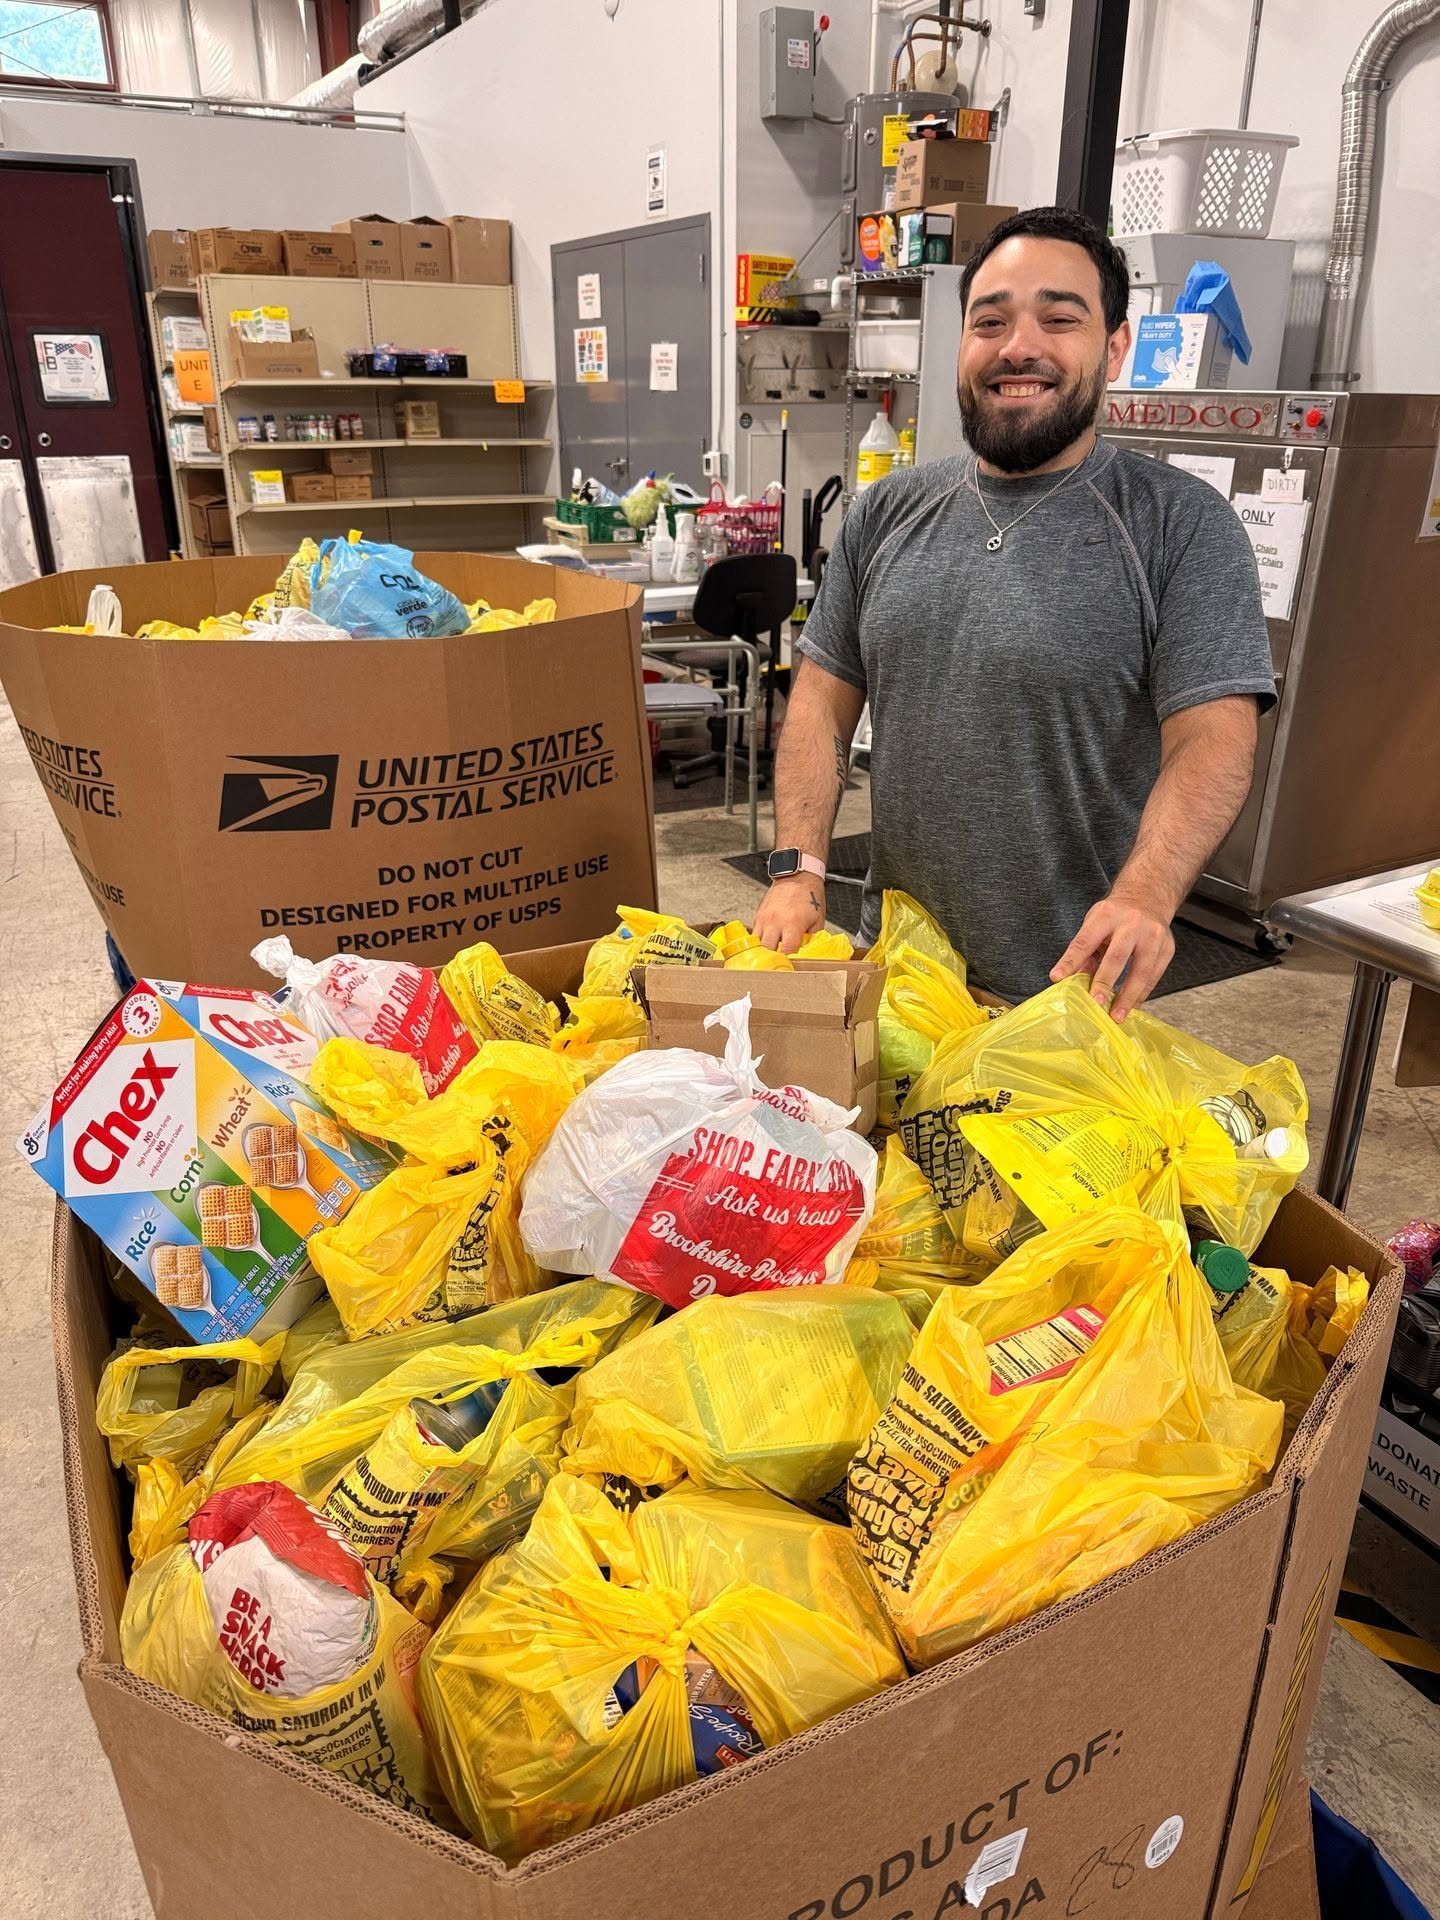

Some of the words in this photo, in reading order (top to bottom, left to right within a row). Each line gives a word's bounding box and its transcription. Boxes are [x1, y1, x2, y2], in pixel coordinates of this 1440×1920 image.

[179, 359, 209, 372] UNIT
[194, 379, 203, 391] E
[1106, 402, 1262, 429] MEDCO
[1267, 478, 1299, 492] DIRTY
[1241, 508, 1276, 524] ONLY
[1255, 543, 1278, 555] Chairs
[1261, 556, 1284, 568] Chairs
[395, 600, 428, 616] verde
[41, 735, 103, 778] STATES
[358, 746, 502, 789] UNITED
[508, 722, 605, 773] STATES
[351, 785, 494, 829] POSTAL
[500, 755, 615, 811] SERVICE
[377, 863, 416, 887] DO
[423, 856, 475, 882] NOT
[480, 846, 524, 873] CUT
[103, 883, 126, 907] USE
[260, 899, 400, 929] DESIGNED
[408, 890, 455, 915] FOR
[463, 868, 569, 906] MULTIPLE
[574, 854, 610, 880] USE
[336, 919, 467, 955] PROPERTY
[473, 911, 503, 932] OF
[509, 897, 562, 925] USPS
[694, 946, 712, 960] MAY
[124, 995, 148, 1024] INCLUDES
[132, 1006, 150, 1026] 3
[144, 1016, 160, 1035] BAGS
[208, 1013, 305, 1049] Chex
[54, 1079, 76, 1105] Perfect
[69, 1070, 83, 1085] for
[76, 1049, 99, 1076] Making
[92, 1034, 111, 1055] Party
[103, 1021, 120, 1039] Mix!
[263, 1083, 295, 1098] Rice
[72, 1047, 179, 1185] Chex
[211, 1096, 253, 1148] Wheat
[143, 1130, 154, 1144] NO
[155, 1140, 166, 1154] NO
[170, 1160, 205, 1204] Corn
[1071, 1172, 1100, 1199] RAMEN
[704, 1185, 758, 1216] Ask
[763, 1203, 791, 1226] us
[796, 1202, 842, 1227] how
[125, 1219, 157, 1262] Rice
[648, 1210, 752, 1280] Brookshire
[1256, 1277, 1279, 1299] MAY
[914, 1433, 964, 1474] ASSOCIATION
[1367, 1455, 1431, 1512] WASTE
[351, 1533, 396, 1546] CARRIERS
[230, 1586, 261, 1625] BE
[258, 1615, 272, 1643] A
[222, 1610, 287, 1681] SNACK
[281, 1691, 356, 1732] SATURDAY
[358, 1680, 374, 1703] IN
[1044, 1728, 1125, 1795] OF:
